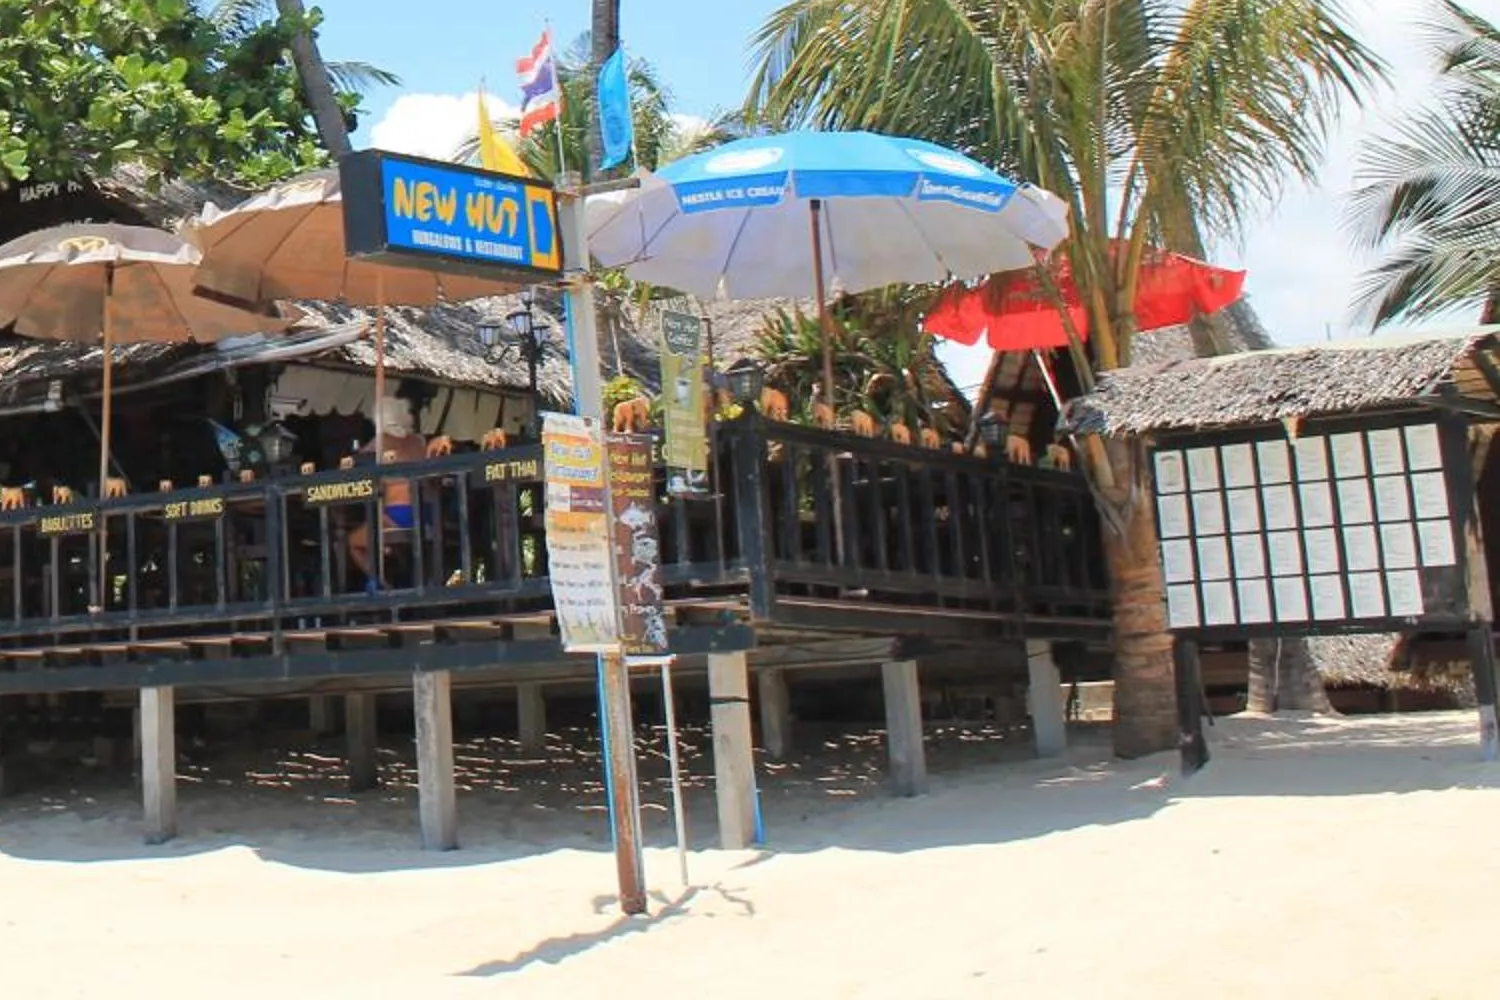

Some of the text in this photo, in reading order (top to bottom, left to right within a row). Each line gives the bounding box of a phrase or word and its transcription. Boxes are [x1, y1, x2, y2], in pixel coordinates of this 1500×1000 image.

[725, 188, 743, 199] ICE
[394, 176, 518, 238] NEW HUT
[510, 459, 537, 477] THAI
[307, 480, 373, 502] SANDWICHES
[165, 501, 188, 519] SOFT
